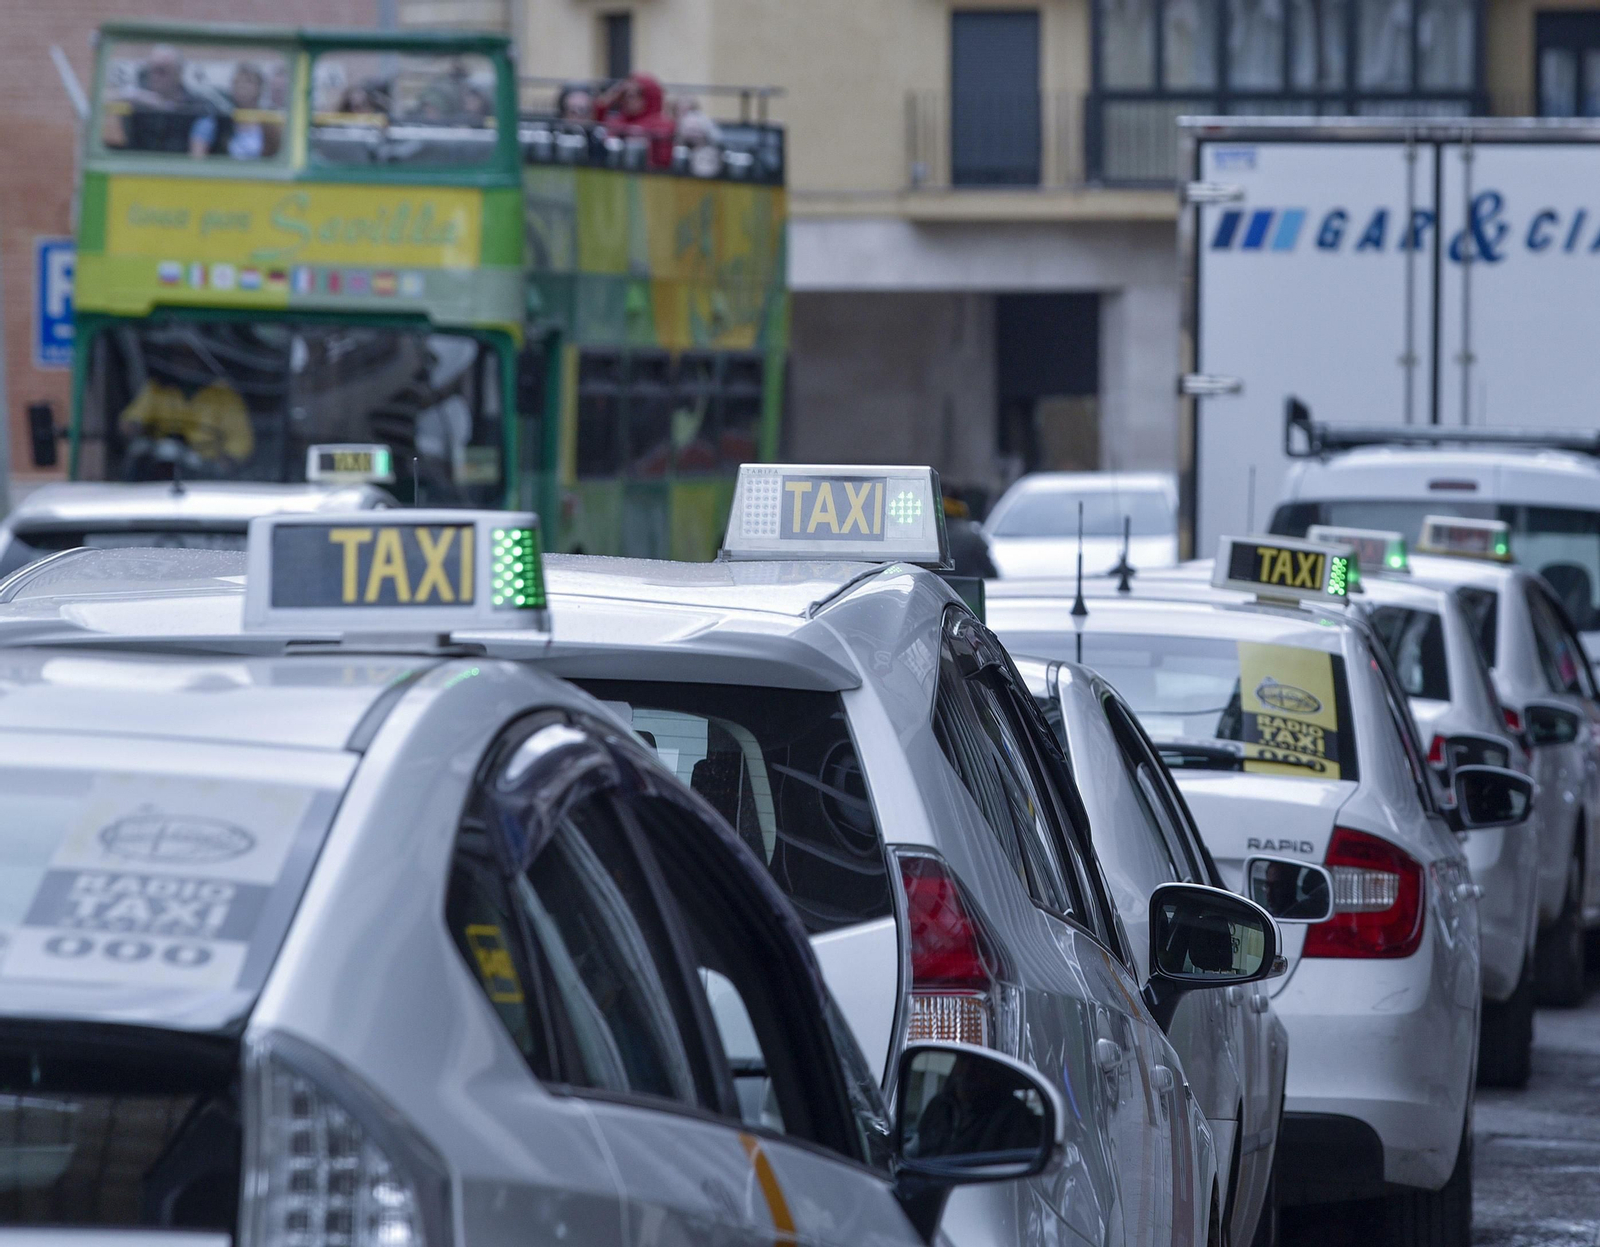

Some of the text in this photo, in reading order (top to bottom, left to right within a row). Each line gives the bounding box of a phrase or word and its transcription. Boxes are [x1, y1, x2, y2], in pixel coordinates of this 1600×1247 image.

[1314, 207, 1438, 253] GAR
[1448, 189, 1511, 264] &
[784, 481, 884, 534] TAXI
[329, 526, 475, 603] TAXI
[1256, 546, 1326, 590] TAXI
[1256, 714, 1325, 738] RADIO
[1258, 725, 1326, 754] TAXI
[1247, 837, 1315, 854] RAPID
[71, 873, 236, 901] RADIO
[73, 897, 232, 937] TAXI
[44, 934, 213, 967] 000
